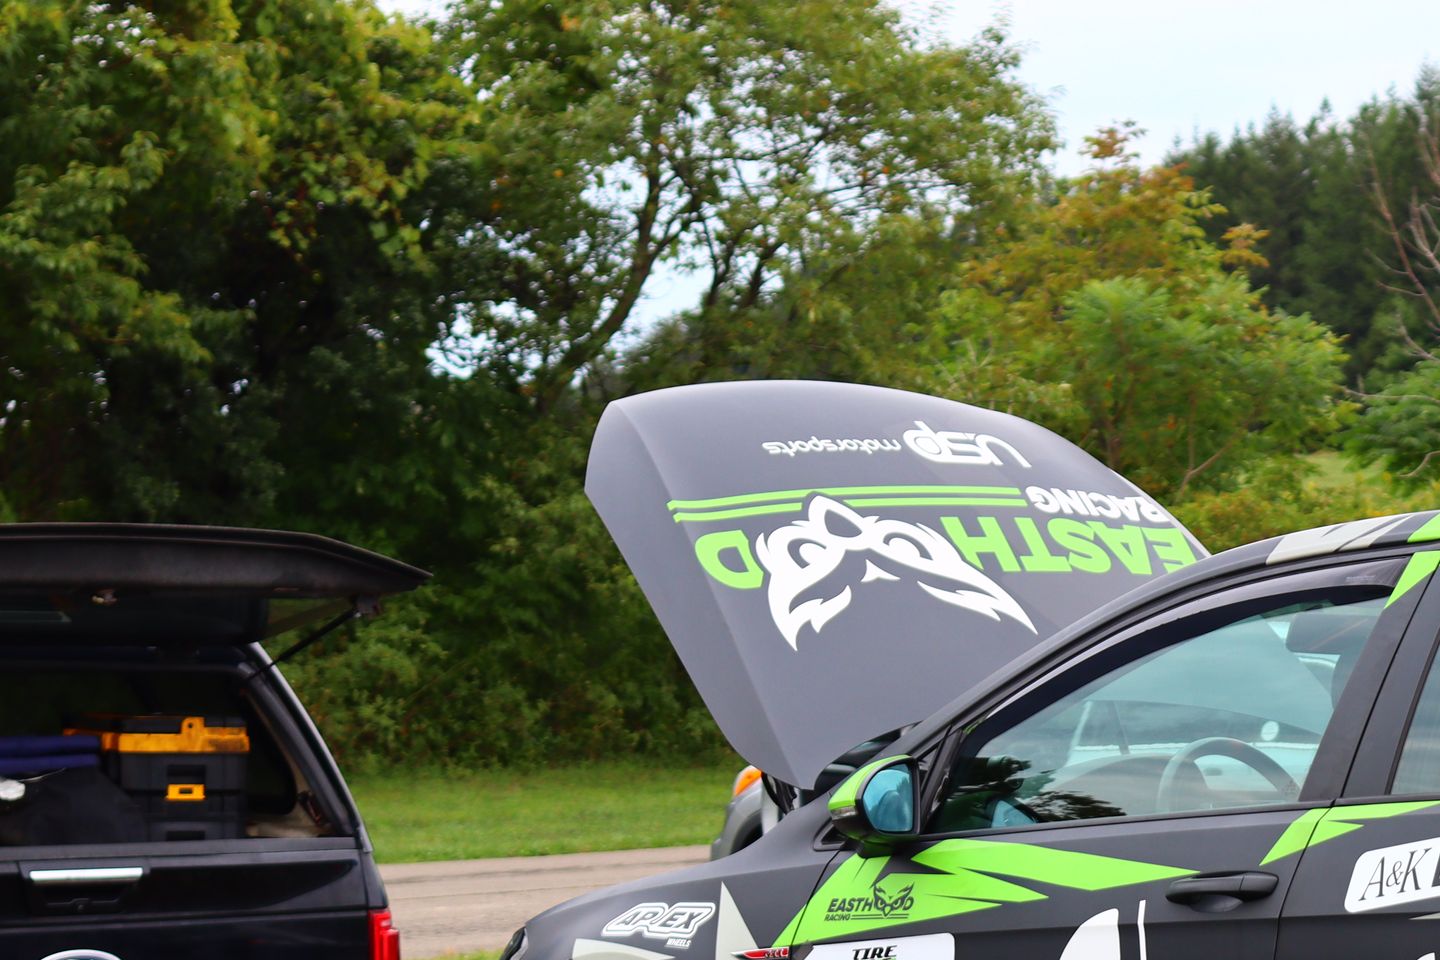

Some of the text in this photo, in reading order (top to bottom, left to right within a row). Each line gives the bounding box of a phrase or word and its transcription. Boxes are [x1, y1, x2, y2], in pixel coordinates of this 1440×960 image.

[765, 421, 1031, 468] USP motorsports
[1025, 486, 1173, 524] RACING
[1359, 848, 1430, 901] A&K
[608, 905, 710, 934] APEX
[824, 913, 850, 922] RACING
[666, 938, 691, 947] WHEELS
[852, 945, 897, 960] TIRE
